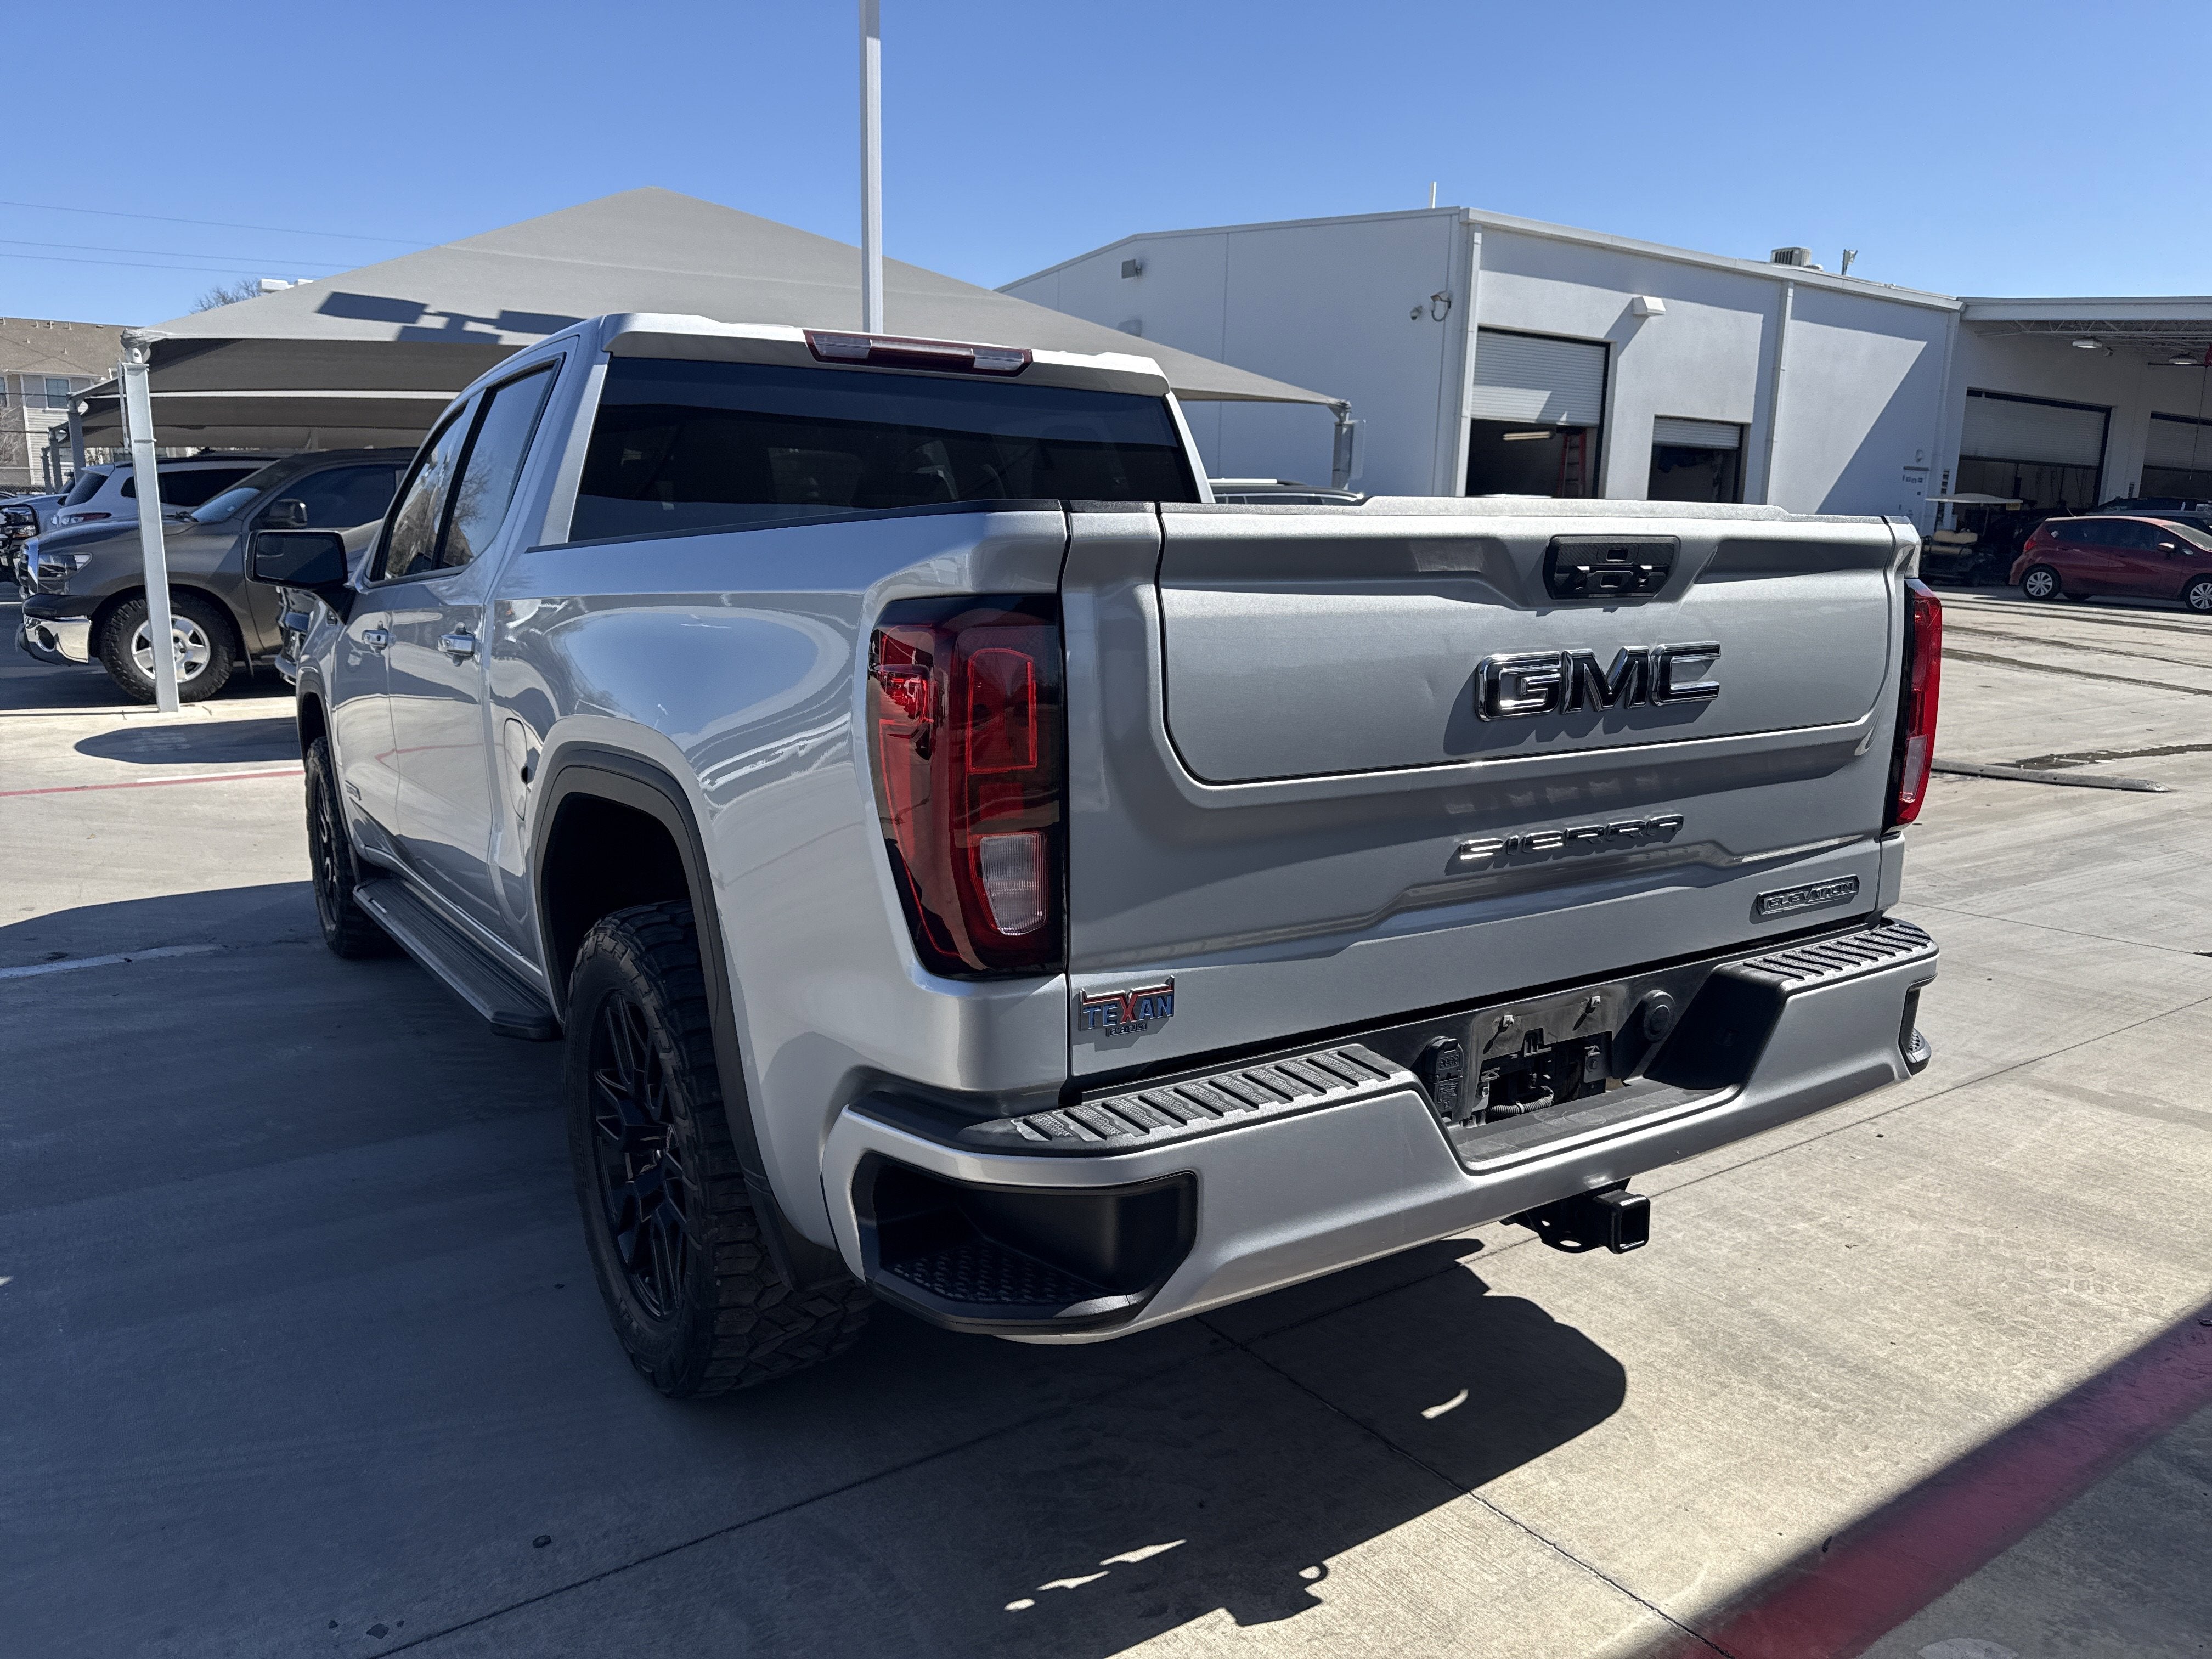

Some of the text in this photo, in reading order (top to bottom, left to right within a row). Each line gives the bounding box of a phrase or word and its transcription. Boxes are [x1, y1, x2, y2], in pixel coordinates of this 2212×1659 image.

[1477, 641, 1722, 721] GMC
[1459, 814, 1684, 860] SIERRA
[1767, 881, 1854, 909] ELEVATION
[1080, 981, 1174, 1030] TEXAN
